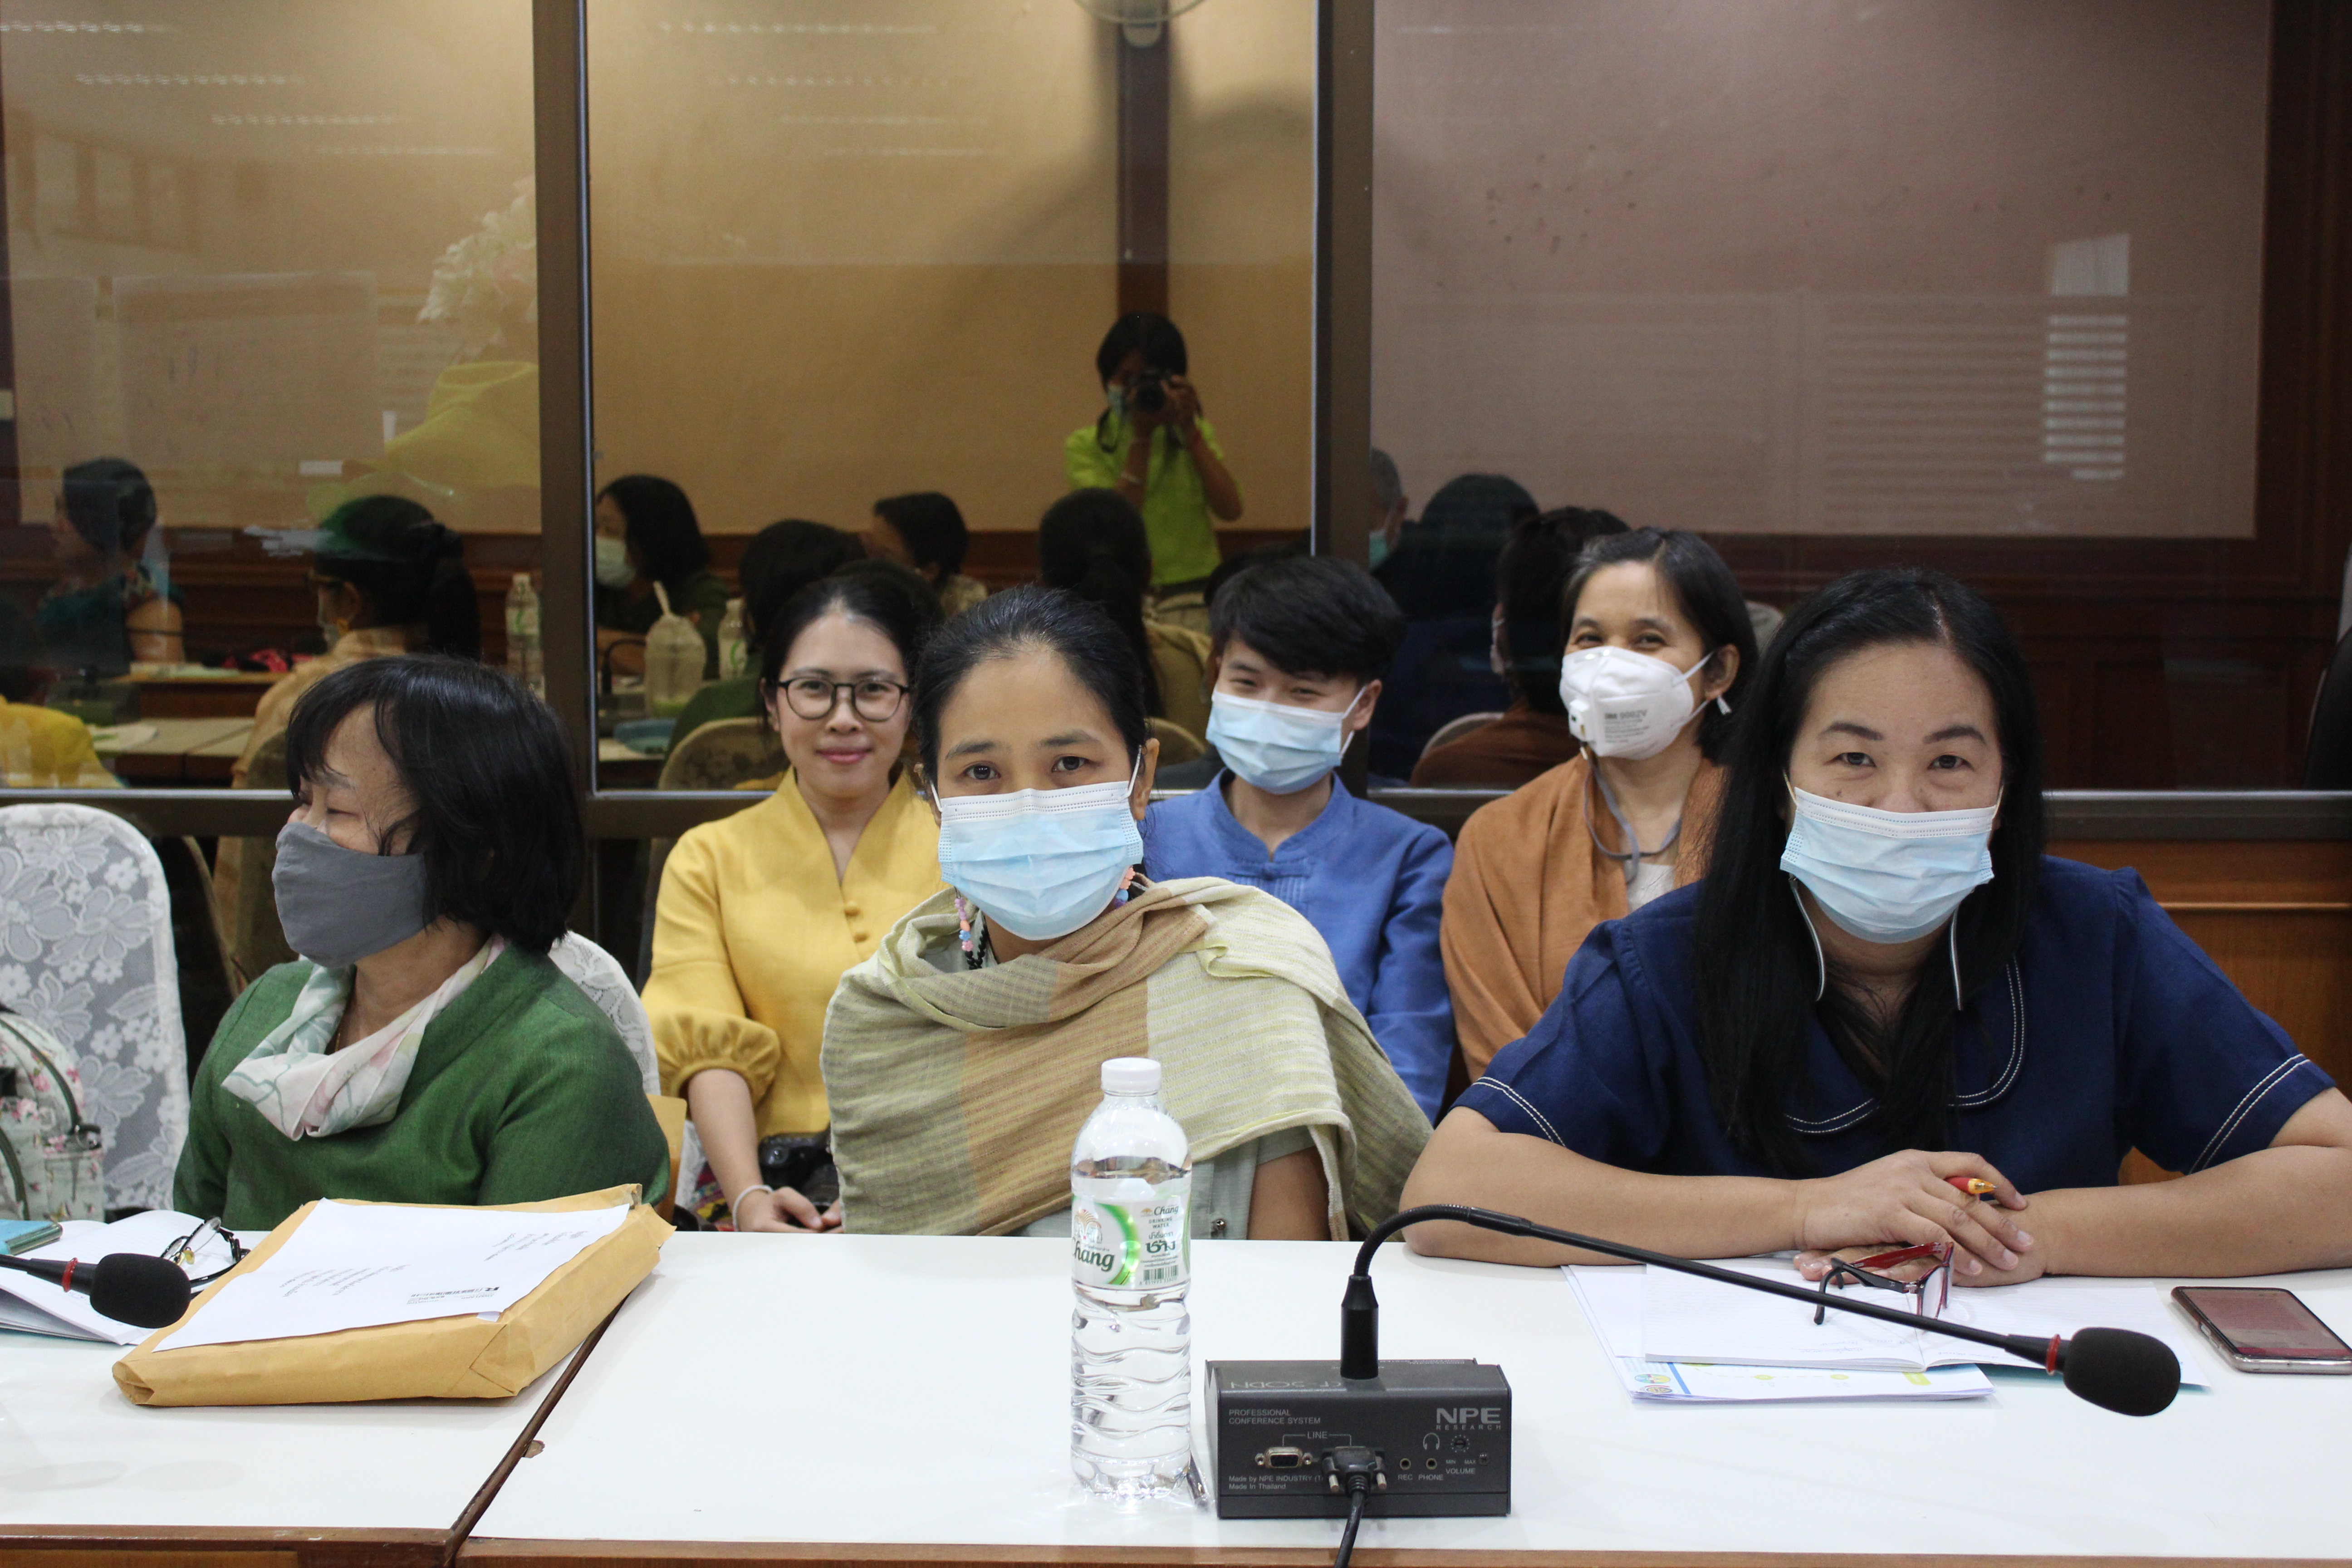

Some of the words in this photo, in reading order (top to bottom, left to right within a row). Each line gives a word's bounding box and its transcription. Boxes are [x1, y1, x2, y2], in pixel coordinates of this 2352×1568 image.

[1154, 1205, 1179, 1216] Chang
[1145, 1240, 1175, 1253] ช้าง
[1073, 1240, 1115, 1272] hang
[1436, 1407, 1501, 1424] NPE
[1249, 1475, 1257, 1484] by
